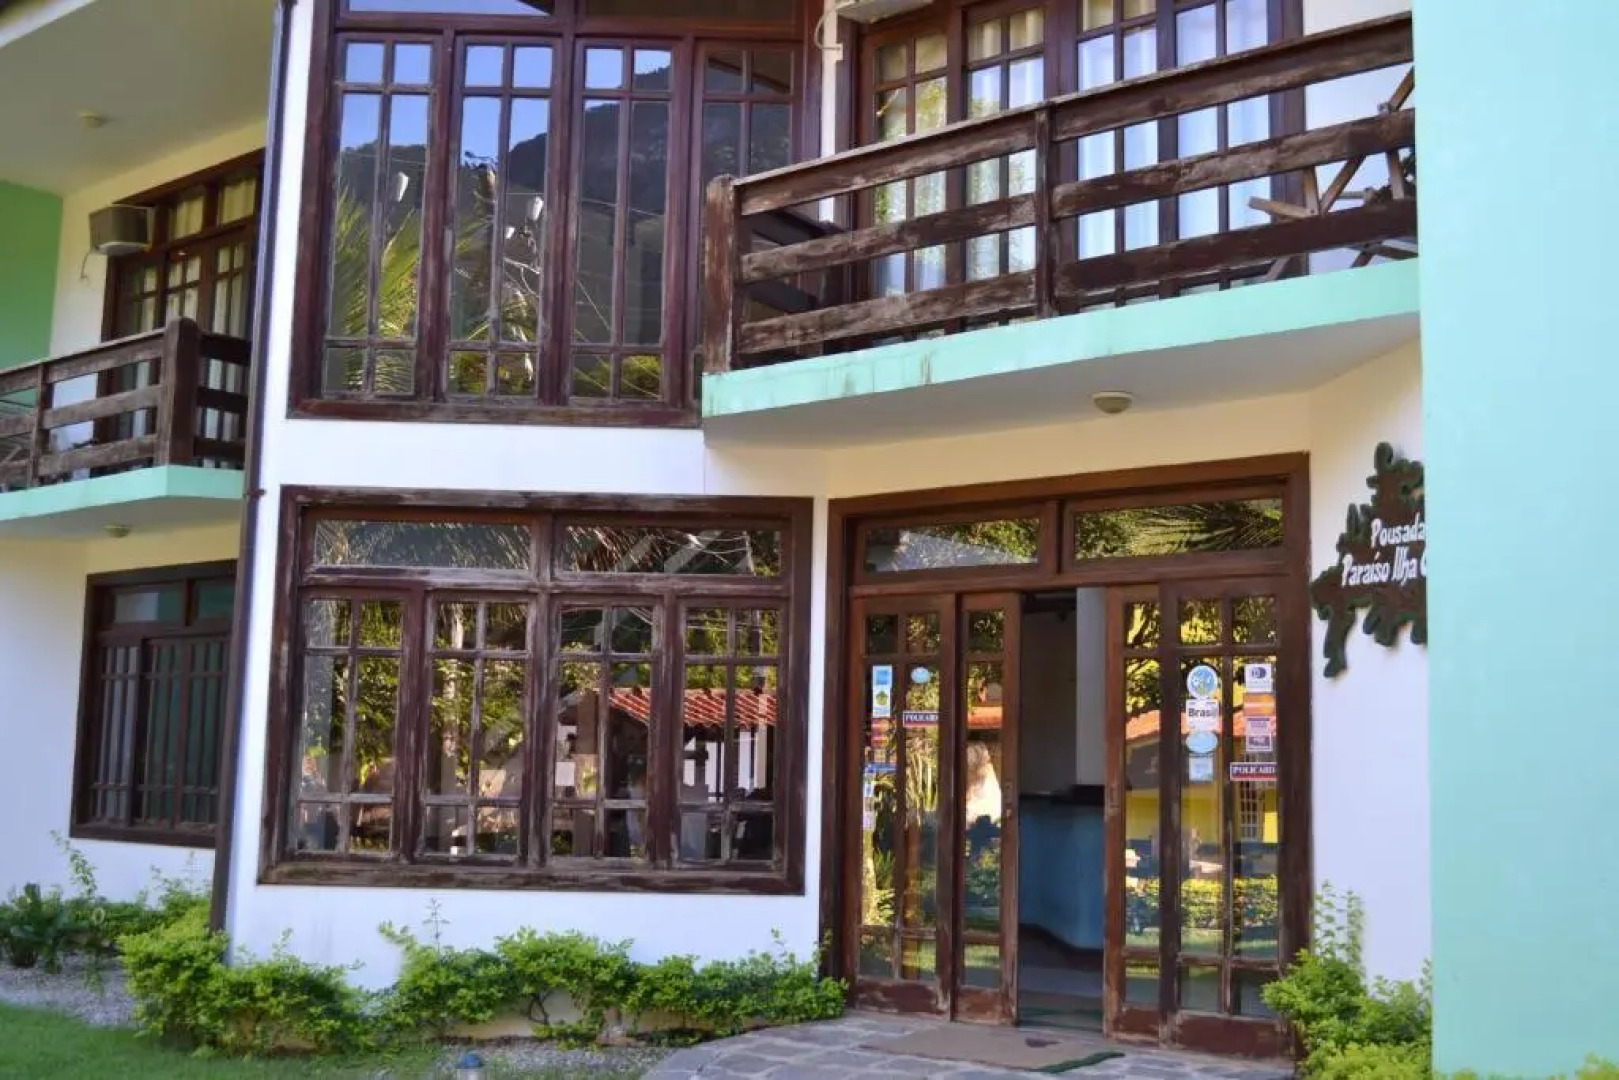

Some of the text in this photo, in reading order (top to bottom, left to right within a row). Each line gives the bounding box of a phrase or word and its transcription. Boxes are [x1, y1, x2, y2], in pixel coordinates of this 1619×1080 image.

[1371, 512, 1426, 548] Pousada
[1341, 551, 1390, 587] Paraíso
[1391, 546, 1418, 586] Ilha
[1188, 708, 1218, 718] Brasil
